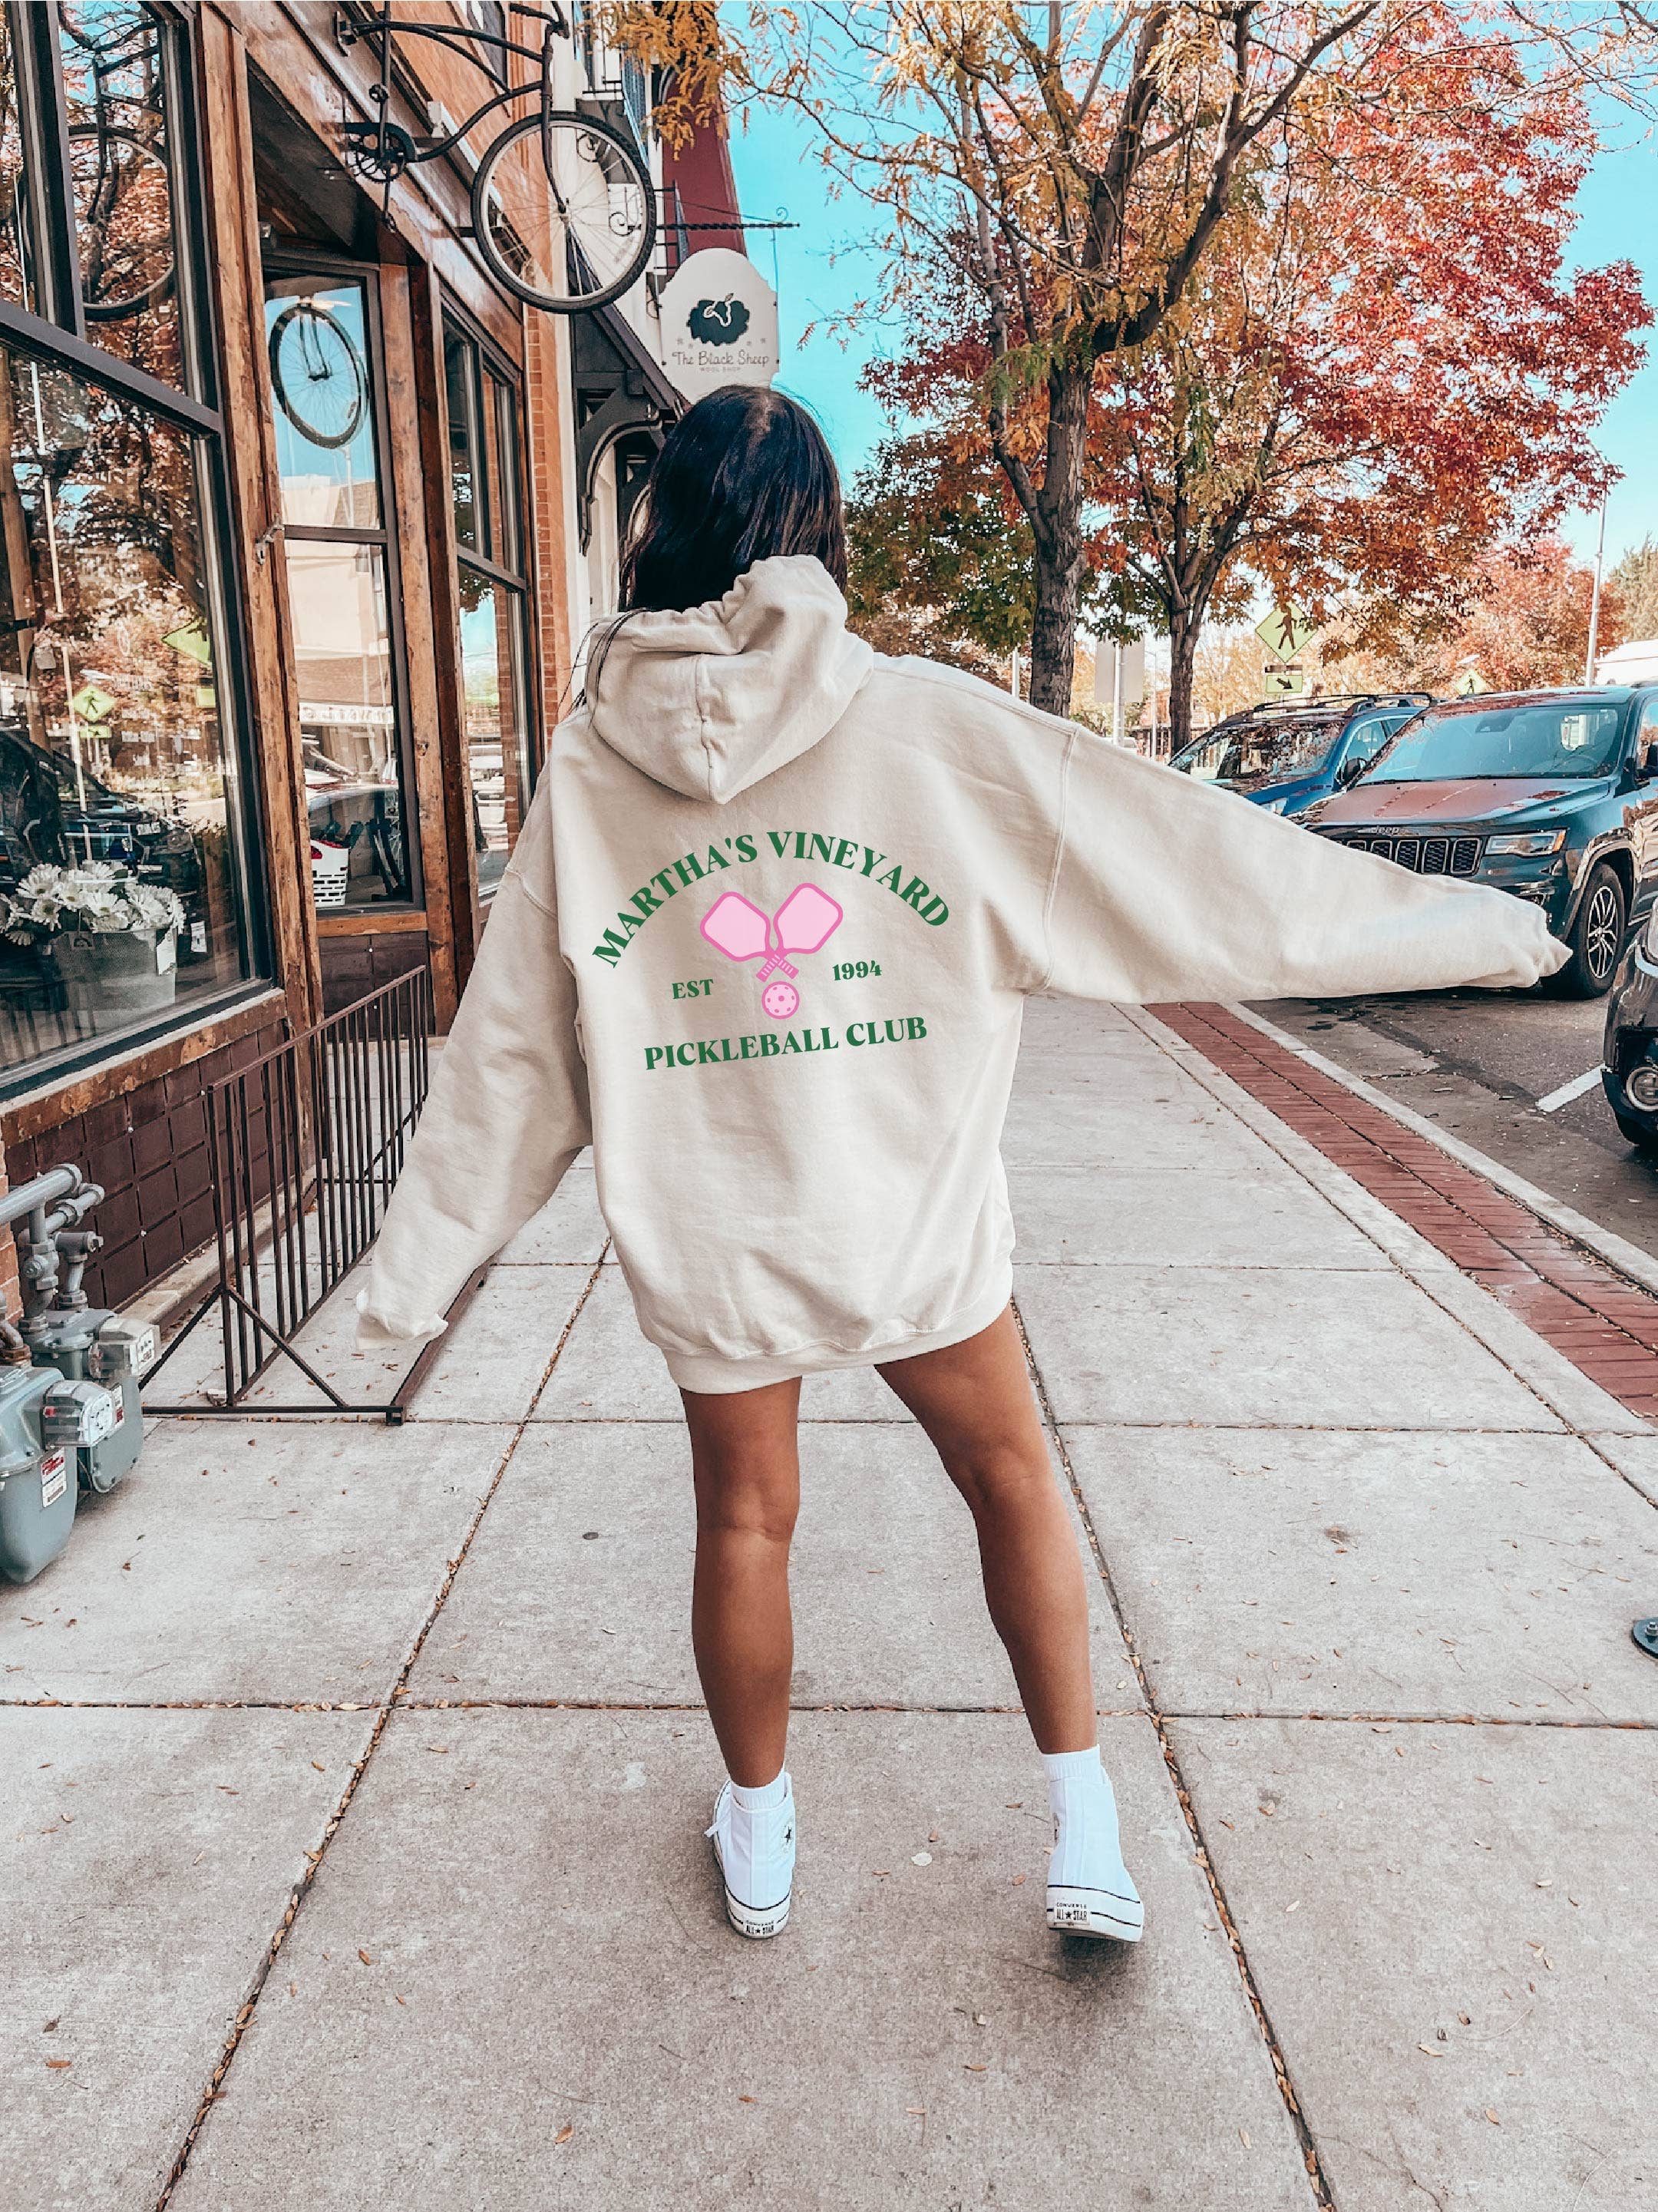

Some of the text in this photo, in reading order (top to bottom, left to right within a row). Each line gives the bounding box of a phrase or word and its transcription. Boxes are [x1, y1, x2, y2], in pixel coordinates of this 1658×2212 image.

[672, 349, 768, 367] The Black Sheep
[592, 832, 950, 968] MARTHA'S VINEYARD
[672, 960, 882, 1000] EST 1994
[644, 1017, 928, 1070] PICKLEBALL CLUB
